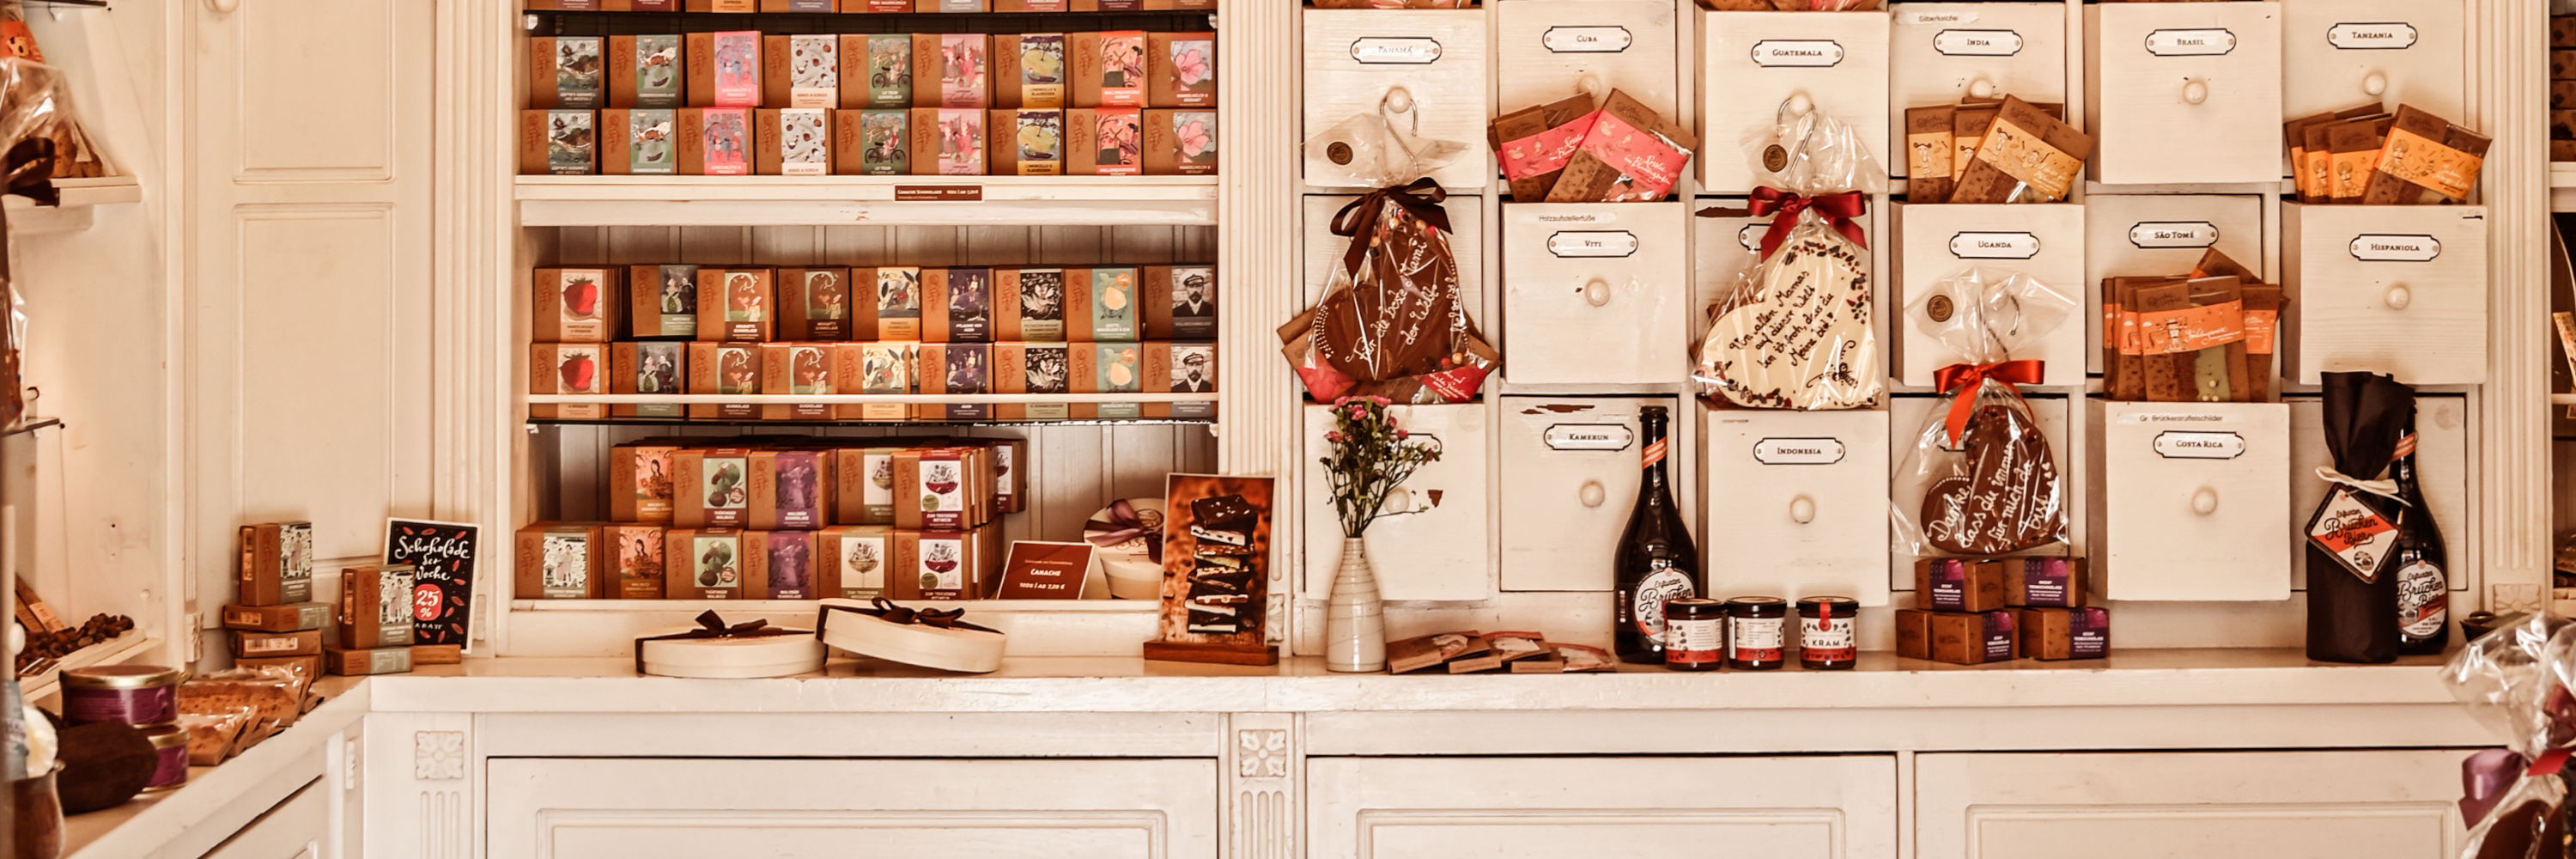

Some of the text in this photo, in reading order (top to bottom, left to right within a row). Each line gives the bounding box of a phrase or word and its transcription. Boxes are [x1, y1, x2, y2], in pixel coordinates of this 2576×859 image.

[2154, 229, 2195, 239] SÃO TOMÉ
[2371, 243, 2421, 252] HISPANIOLA
[2202, 440, 2224, 448] RICA
[1777, 447, 1822, 455] INDONESIA
[416, 589, 440, 606] 25
